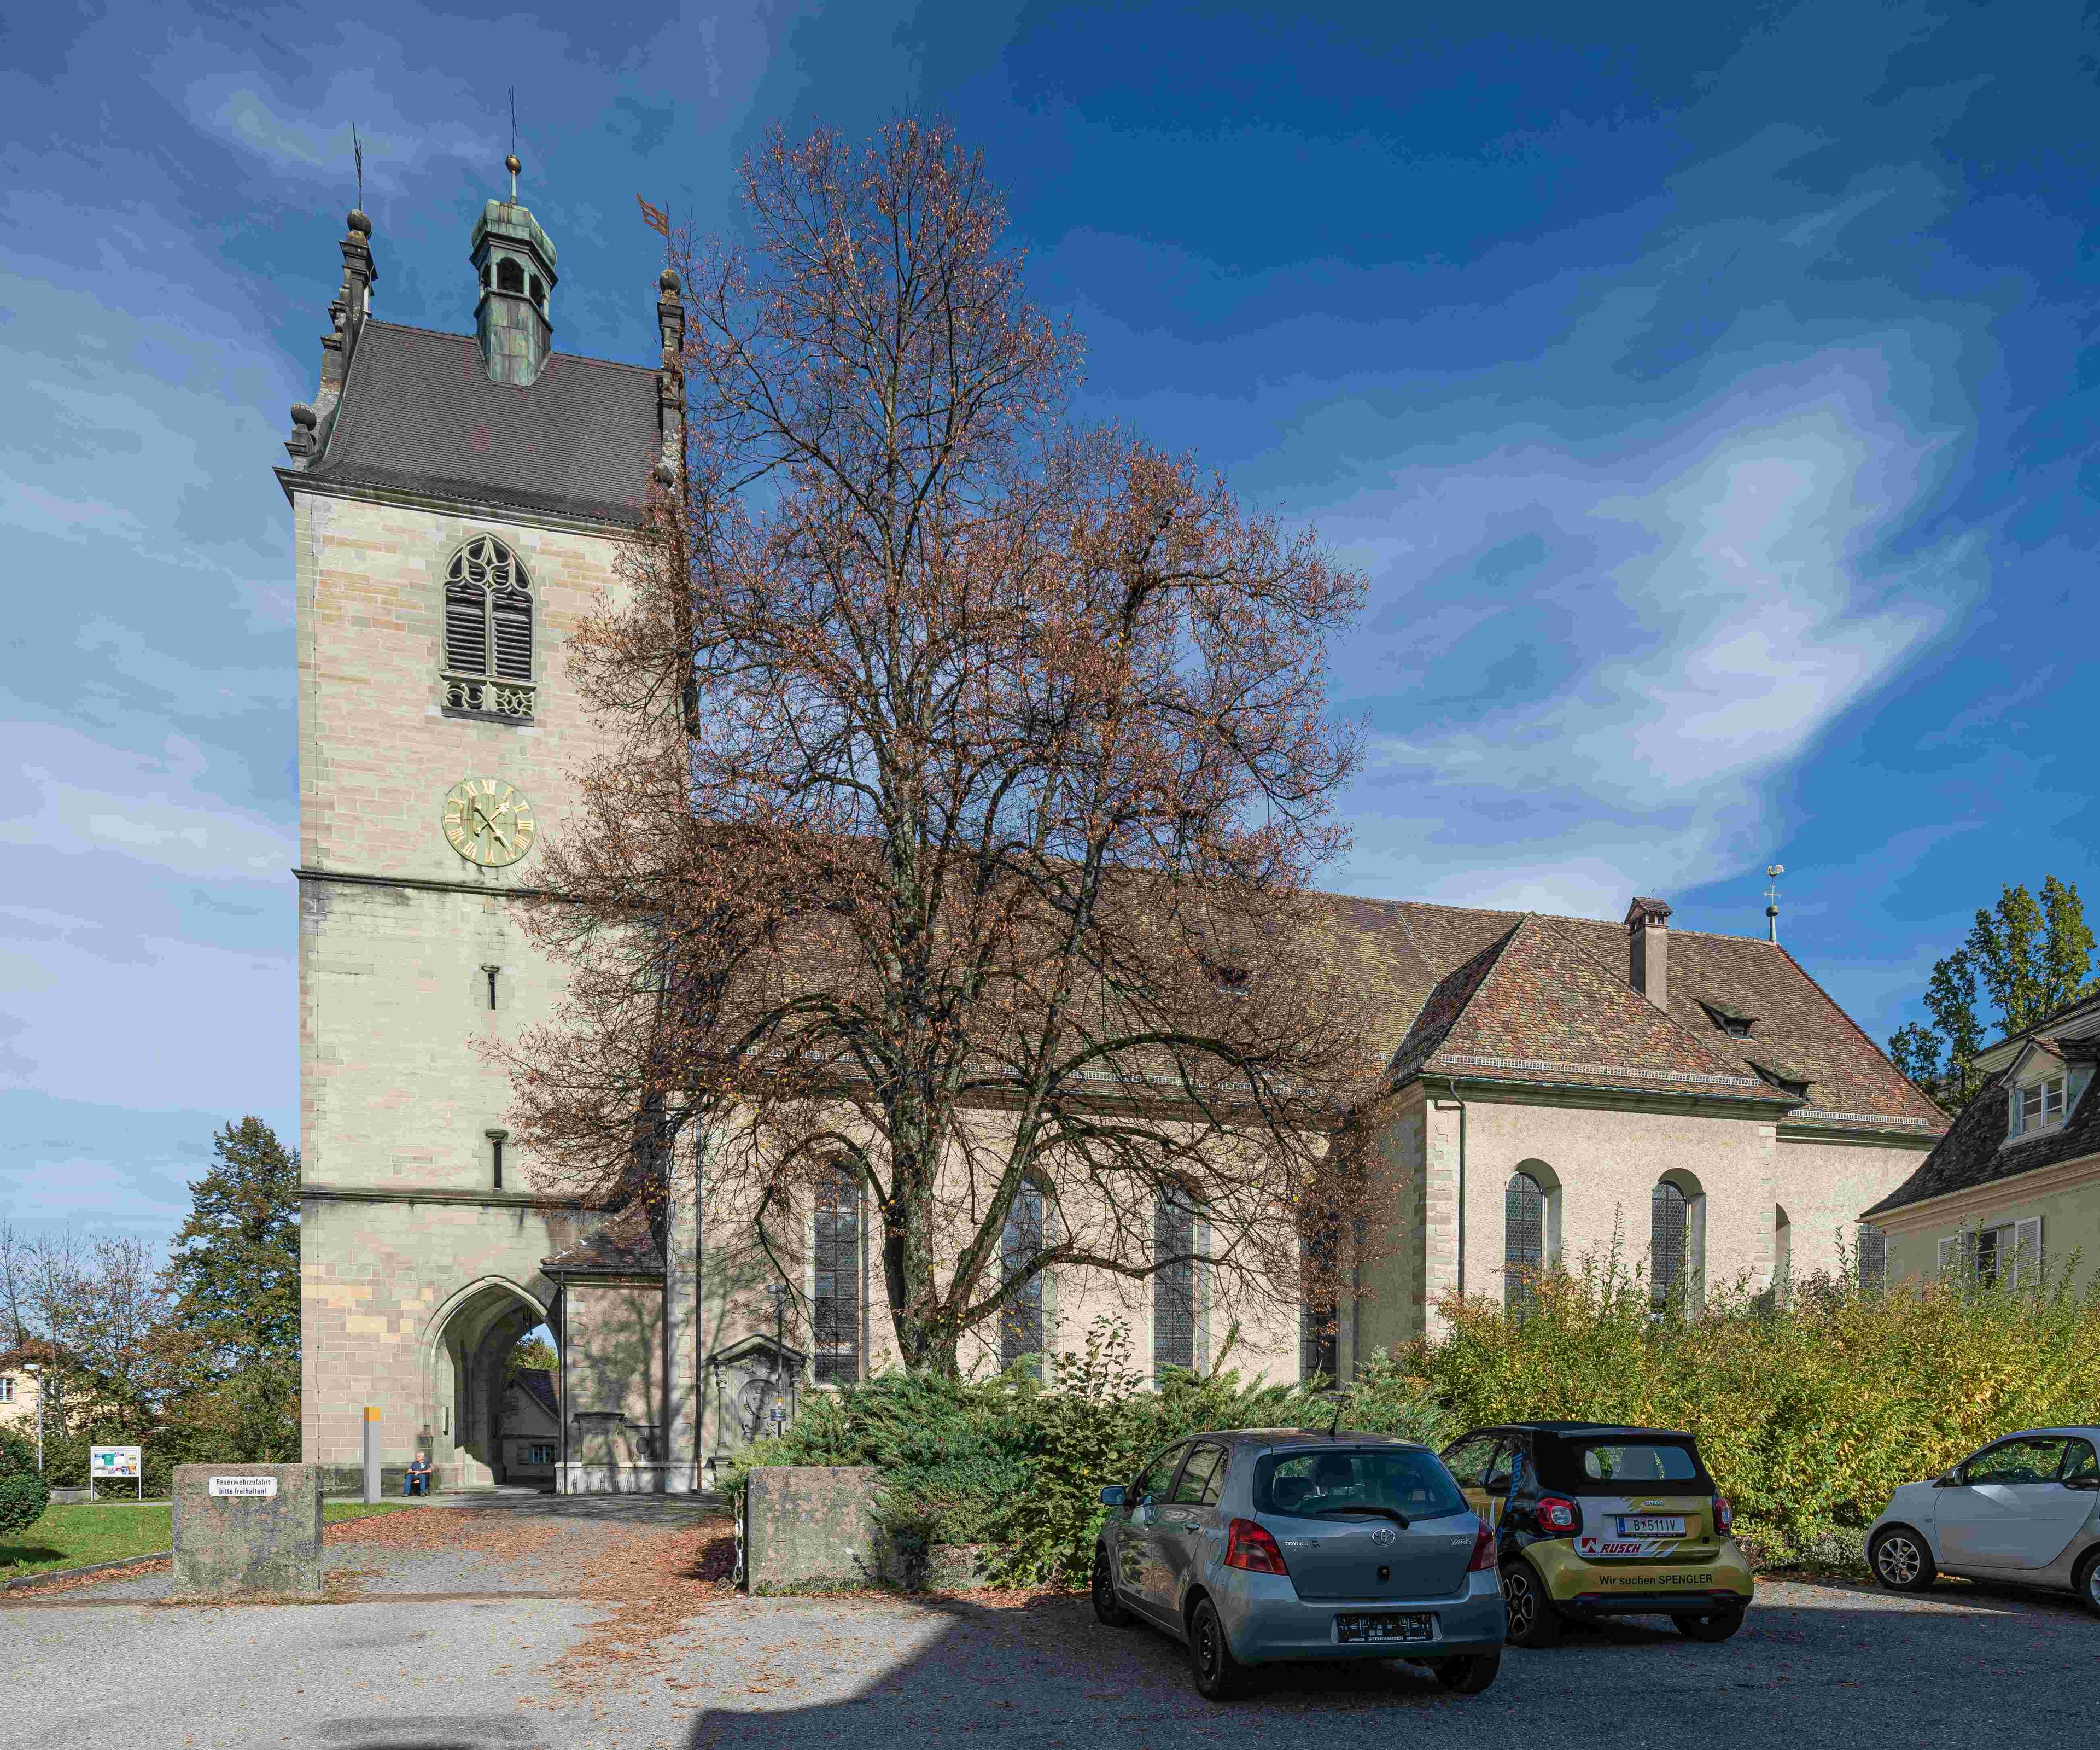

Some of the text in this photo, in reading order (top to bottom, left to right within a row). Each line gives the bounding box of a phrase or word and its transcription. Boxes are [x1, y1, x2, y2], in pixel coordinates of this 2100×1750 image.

[463, 780, 479, 798] XI
[481, 780, 498, 795] XII
[502, 786, 514, 801] I
[448, 792, 466, 809] X
[512, 800, 529, 813] II
[445, 810, 460, 824] IX
[517, 819, 534, 831] III
[448, 826, 465, 844] VIII
[461, 840, 477, 860] VII
[483, 848, 497, 864] VI
[1633, 1519, 1640, 1531] B
[1450, 1538, 1472, 1546] YARIS
[1600, 1543, 1642, 1553] RUSCH
[1599, 1574, 1713, 1585] Wir suchen SPENGLER
